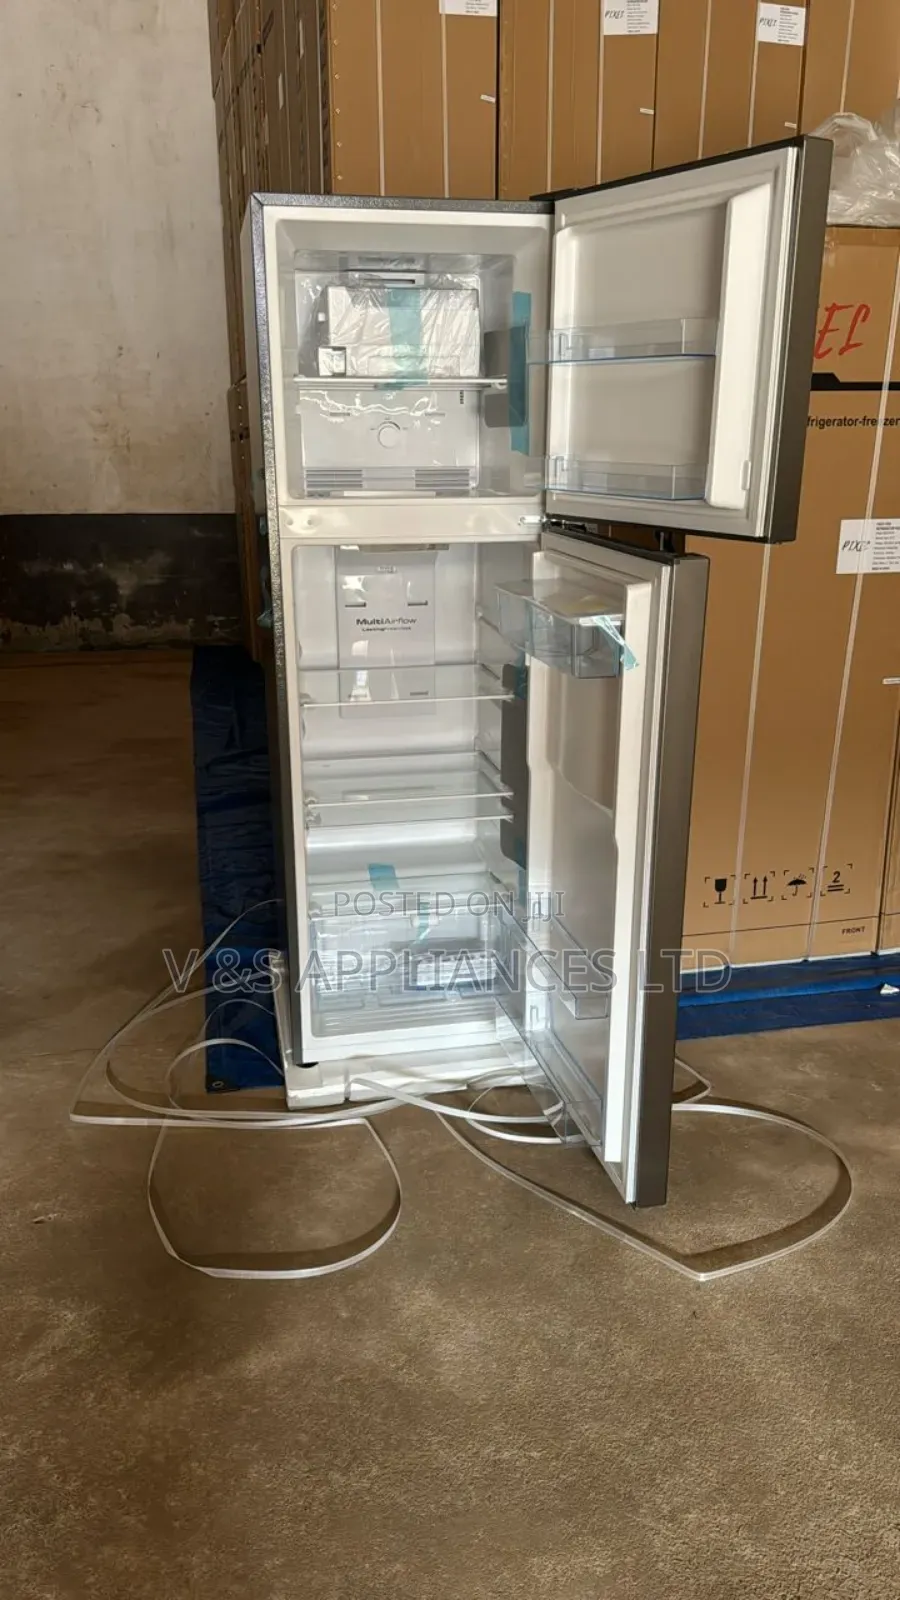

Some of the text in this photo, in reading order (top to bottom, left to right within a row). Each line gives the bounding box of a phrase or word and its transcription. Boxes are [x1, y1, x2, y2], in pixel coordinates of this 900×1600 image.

[806, 415, 900, 430] frigerator-frezer
[832, 870, 841, 884] 2
[842, 925, 866, 935] FRONT
